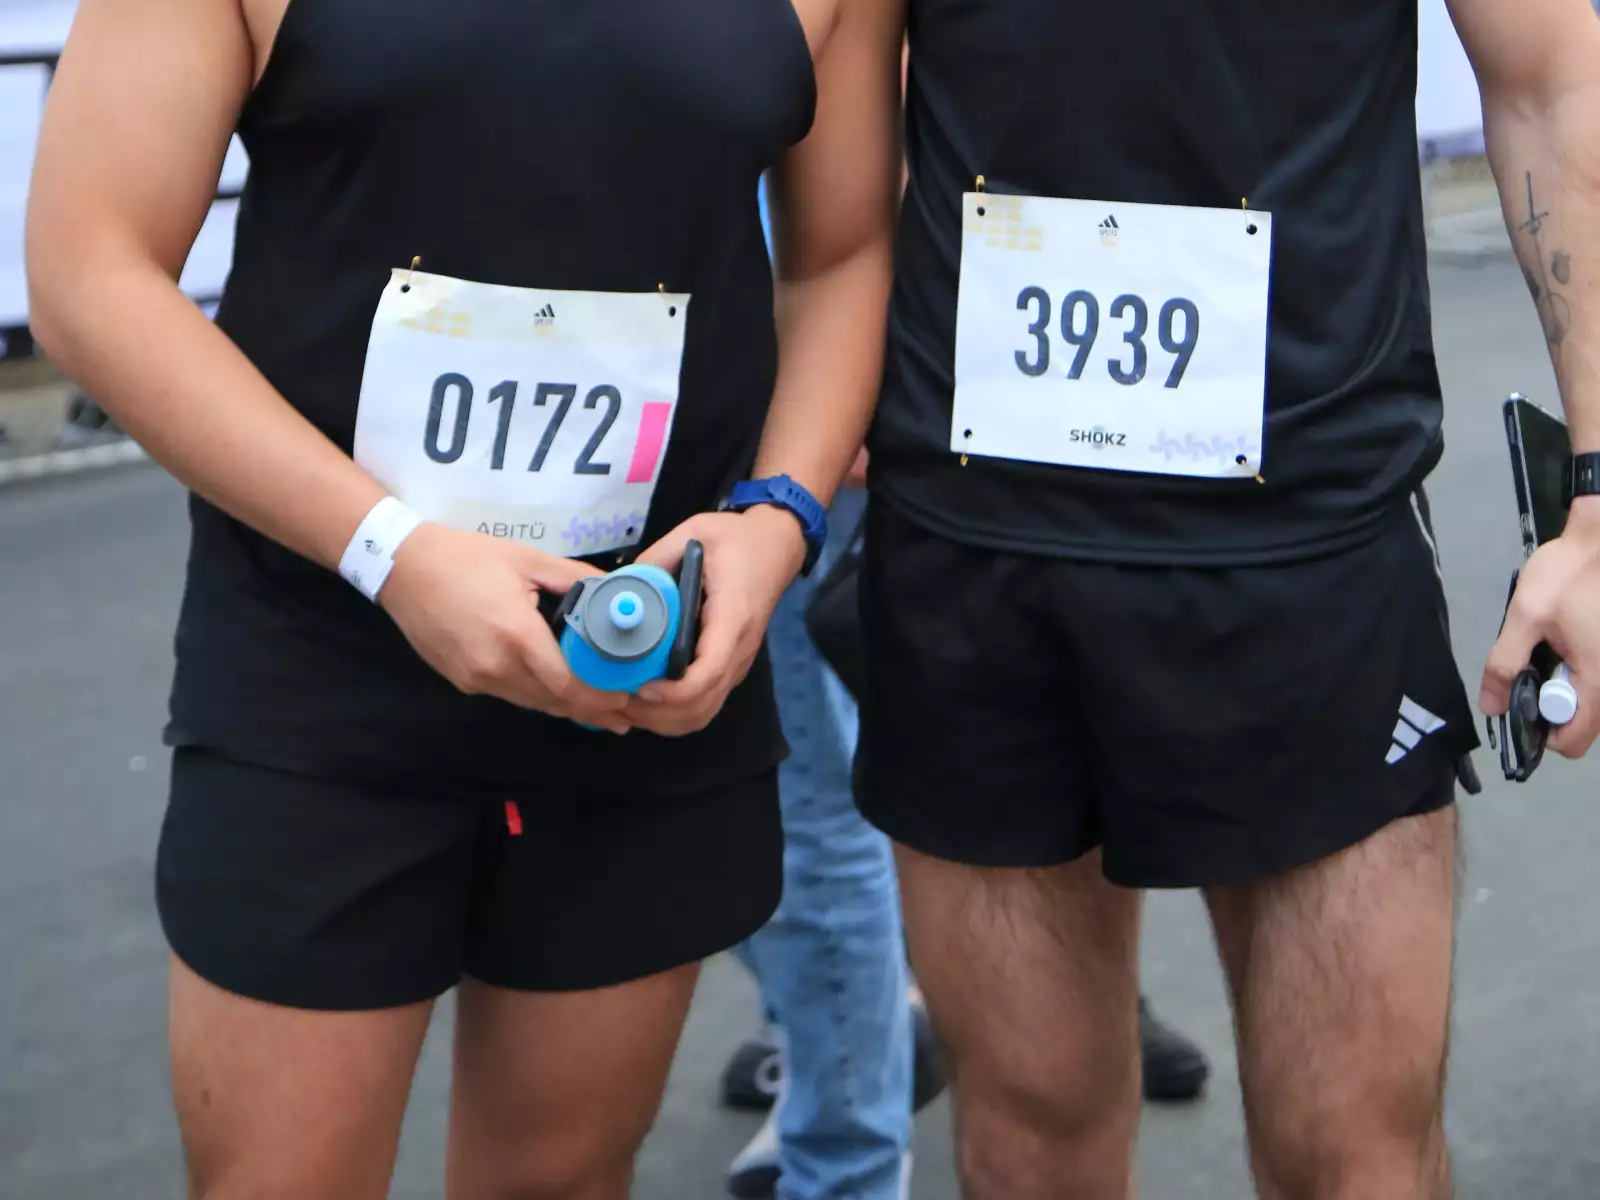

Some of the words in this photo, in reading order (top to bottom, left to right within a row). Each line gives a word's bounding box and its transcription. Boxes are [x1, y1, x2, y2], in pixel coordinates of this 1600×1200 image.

[1015, 286, 1199, 388] 3939
[424, 373, 621, 475] 0172
[1070, 429, 1126, 446] SHOKZ
[476, 521, 545, 540] ABITÜ
